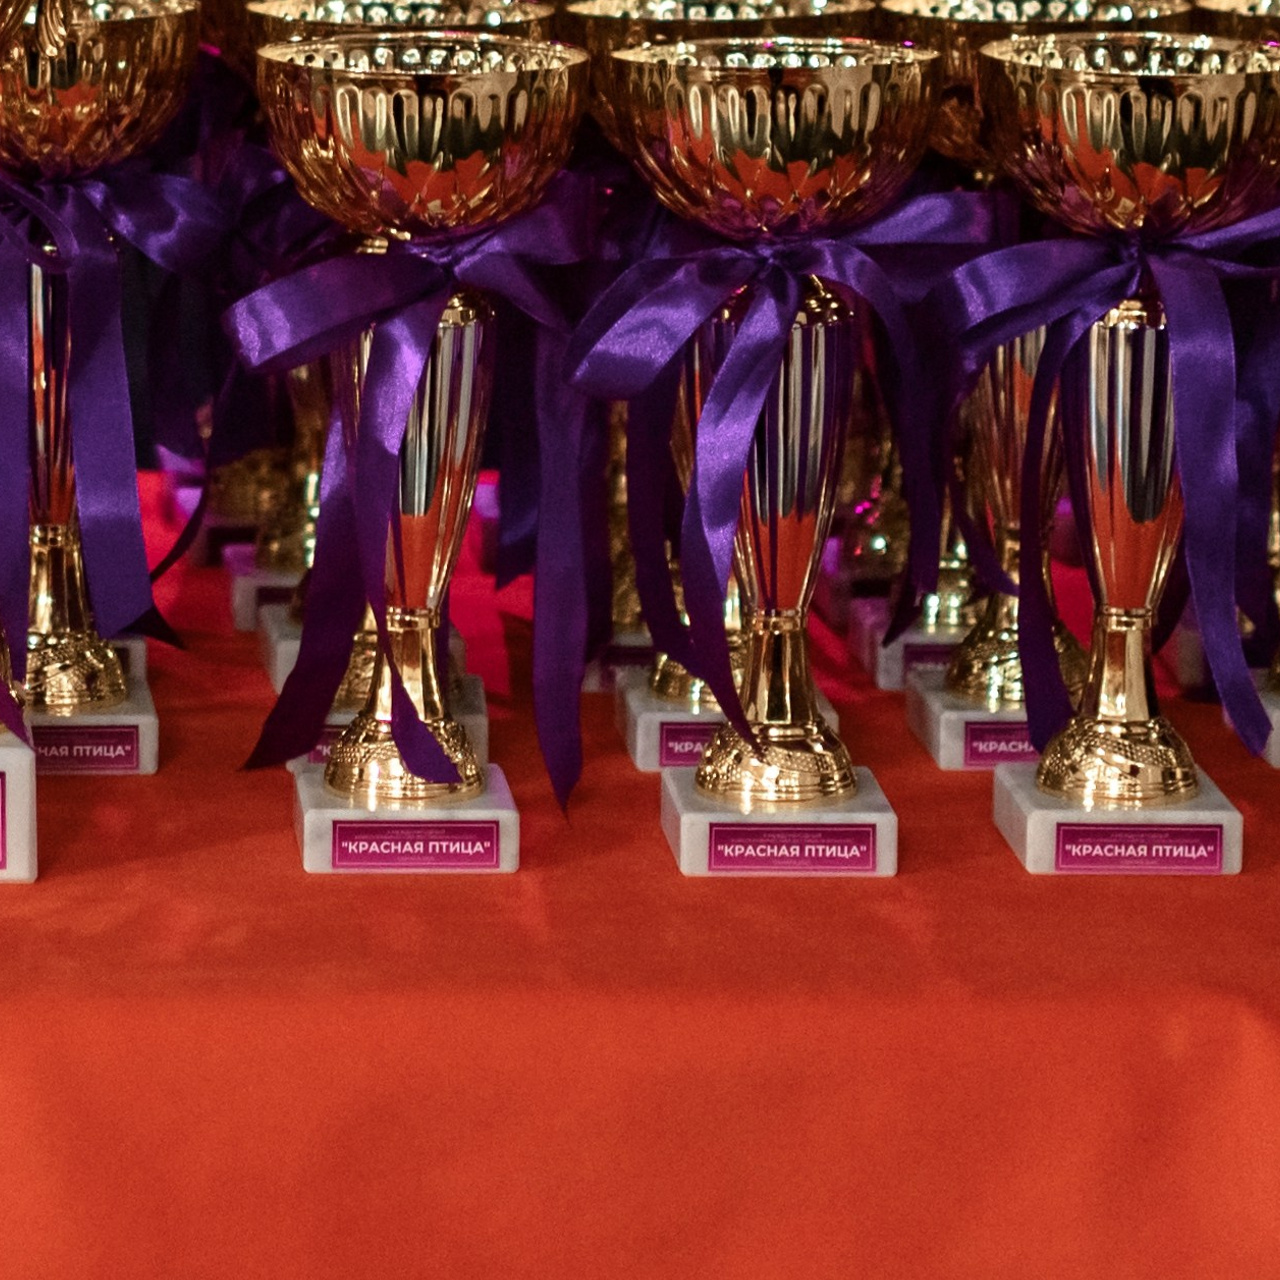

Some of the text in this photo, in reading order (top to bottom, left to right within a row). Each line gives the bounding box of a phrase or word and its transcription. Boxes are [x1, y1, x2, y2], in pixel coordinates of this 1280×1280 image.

[73, 745, 131, 758] ПТИЦА"
[342, 841, 491, 855] "КРАСНАЯ ПТИЦА"
[717, 845, 867, 859] "КРАСНАЯ ПТИЦА"
[1065, 845, 1214, 859] "КРАСНАЯ ПТИЦА"
